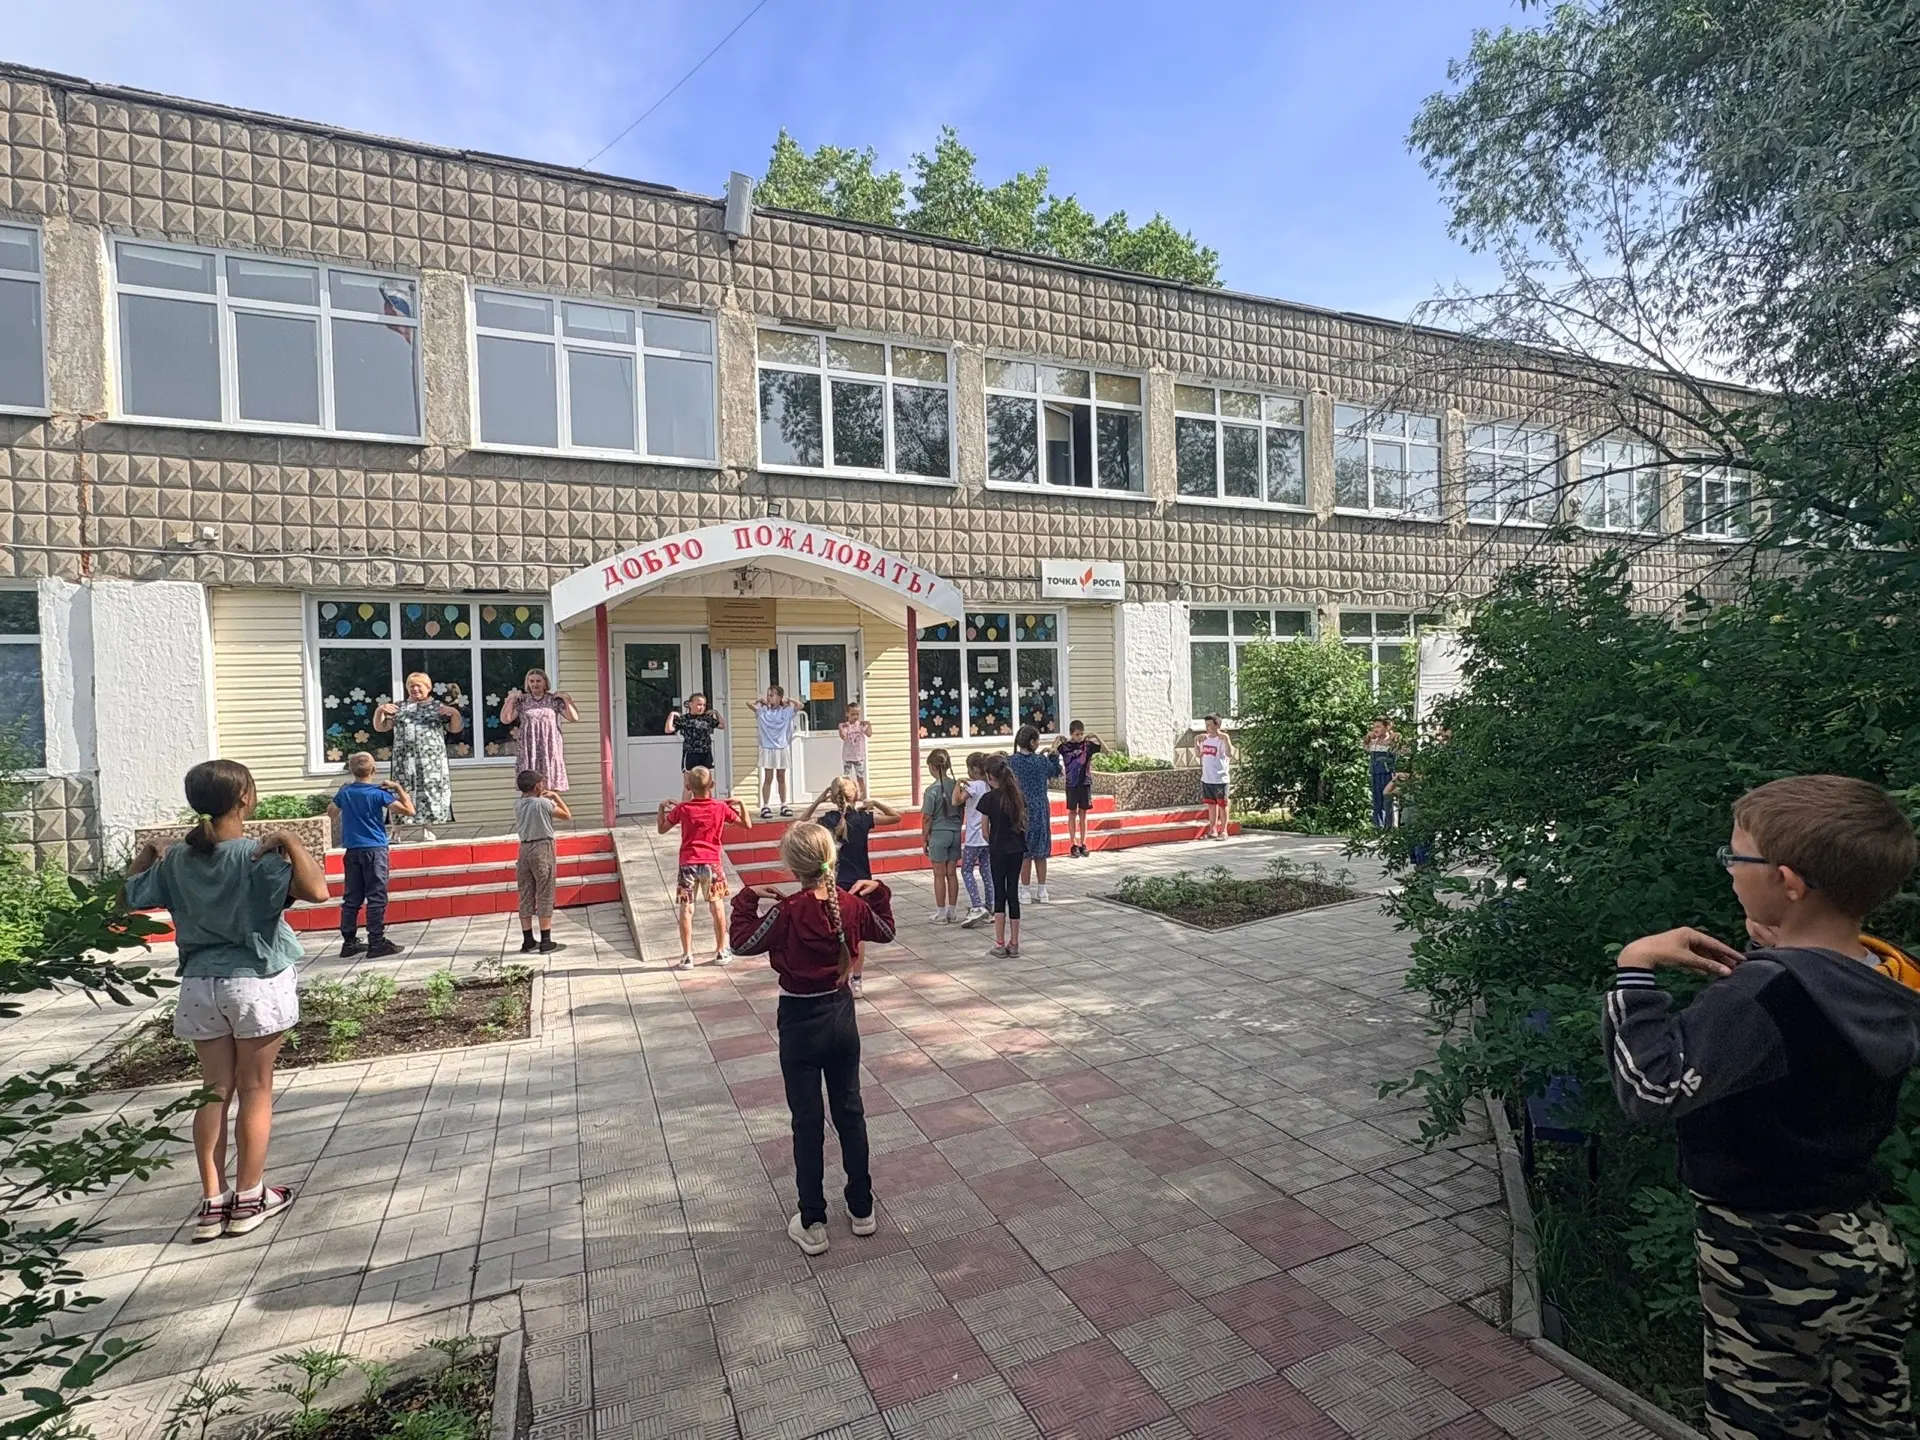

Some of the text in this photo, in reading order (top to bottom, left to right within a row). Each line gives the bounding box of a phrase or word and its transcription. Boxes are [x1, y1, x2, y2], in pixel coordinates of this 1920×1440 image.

[601, 524, 936, 599] ДОБРО ПОЖАЛОВАТЬ!
[1046, 576, 1121, 588] ТОЧКА РОСТА
